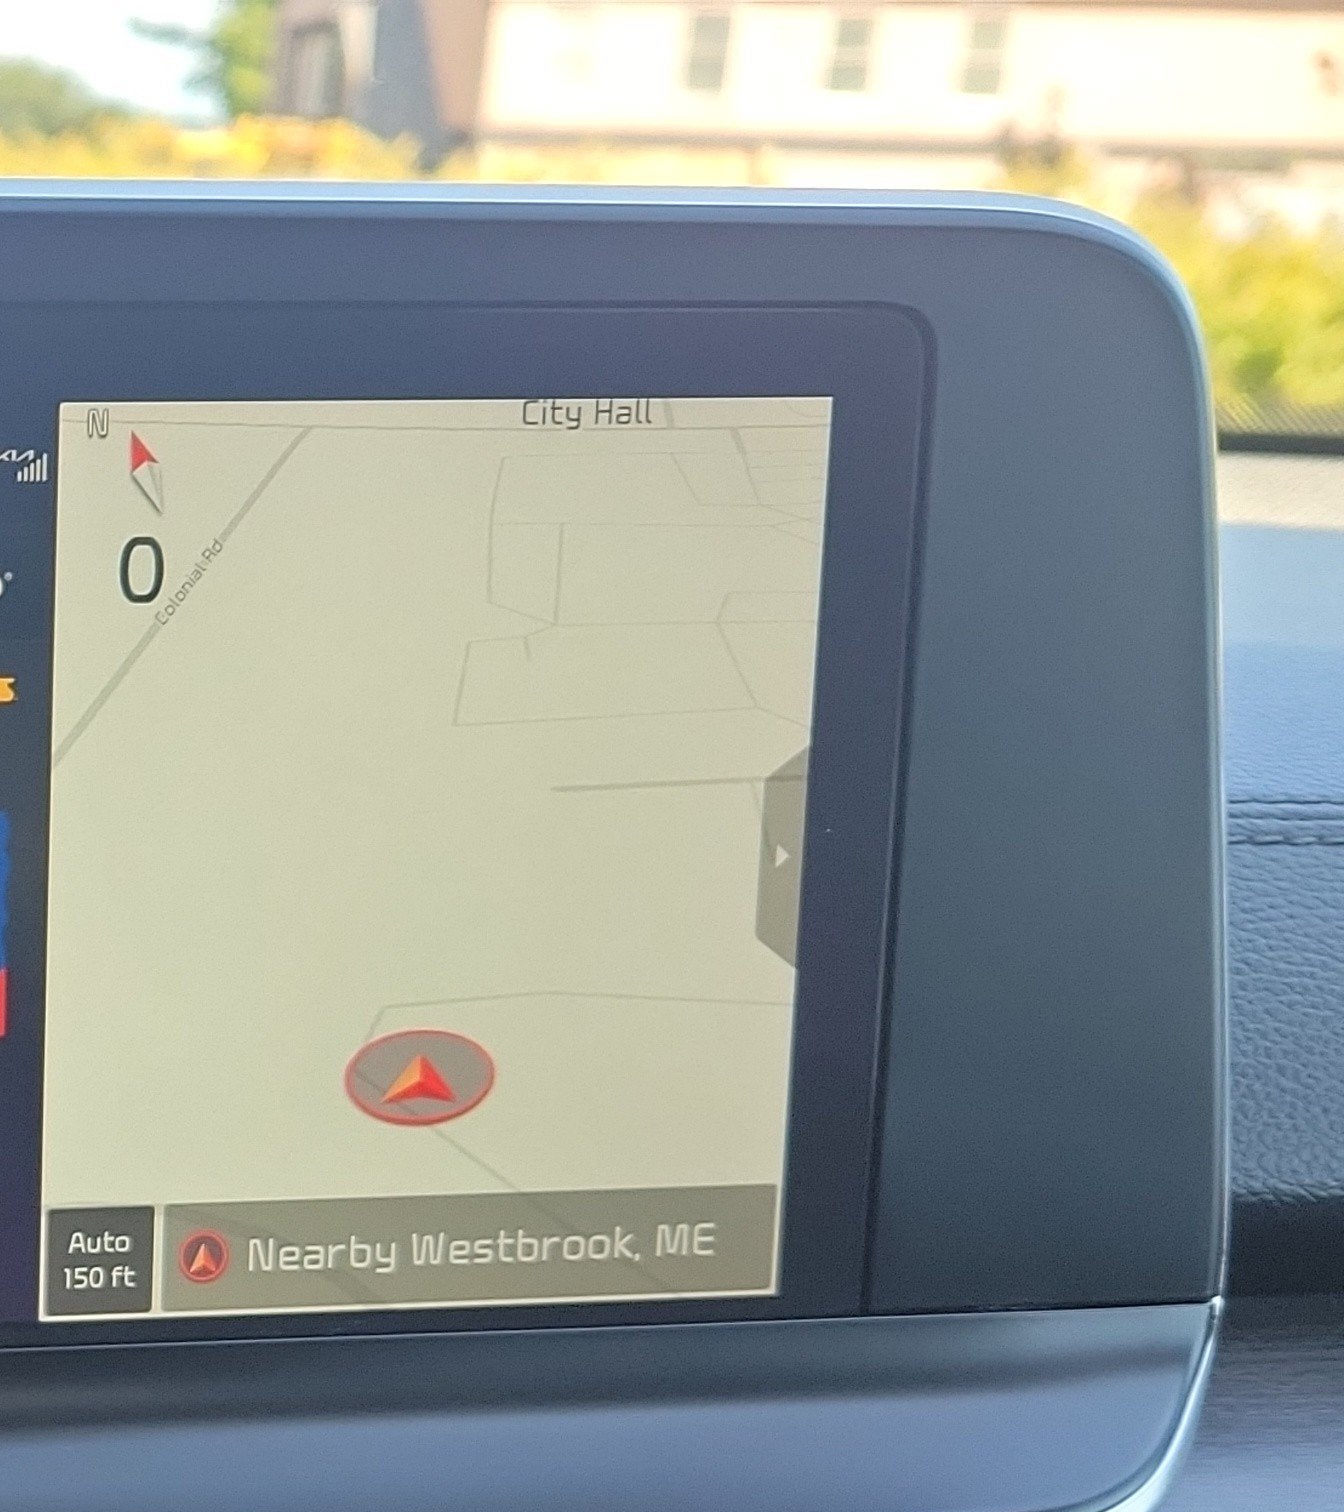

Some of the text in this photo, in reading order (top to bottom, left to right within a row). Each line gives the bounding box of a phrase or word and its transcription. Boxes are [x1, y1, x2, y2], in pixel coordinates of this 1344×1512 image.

[87, 408, 109, 438] N
[522, 399, 652, 430] City Hall
[119, 536, 164, 604] 0
[155, 538, 224, 626] Colonial Rd
[67, 1230, 131, 1254] Auto
[247, 1222, 716, 1273] Nearby Westbrook, ME
[62, 1264, 136, 1290] 150 ft
